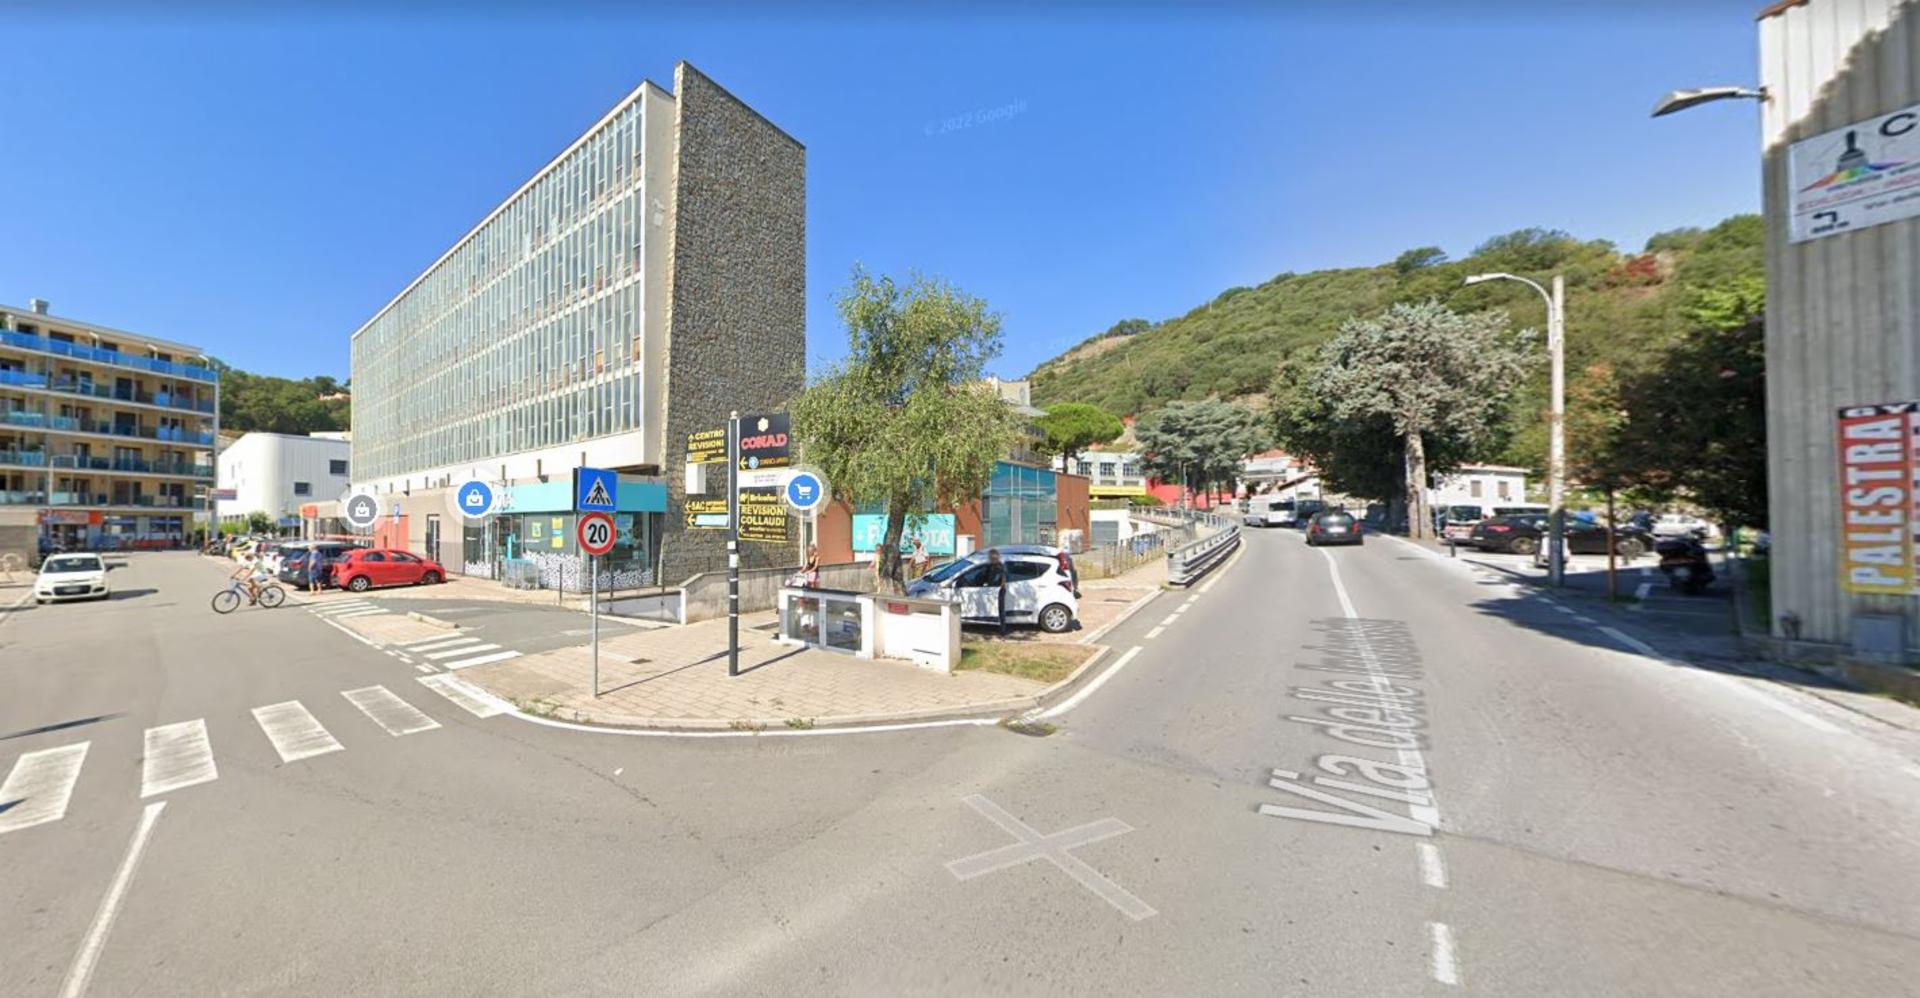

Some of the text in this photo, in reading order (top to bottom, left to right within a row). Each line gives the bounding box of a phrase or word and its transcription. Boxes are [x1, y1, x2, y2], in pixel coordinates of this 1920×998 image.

[695, 428, 725, 440] CENTRO
[687, 439, 725, 451] REVISIONI
[740, 433, 788, 450] CONAD
[1845, 417, 1905, 587] PALESTRA
[740, 504, 788, 516] REVISIONI
[740, 515, 786, 527] COLLAUDI
[587, 523, 608, 544] 20
